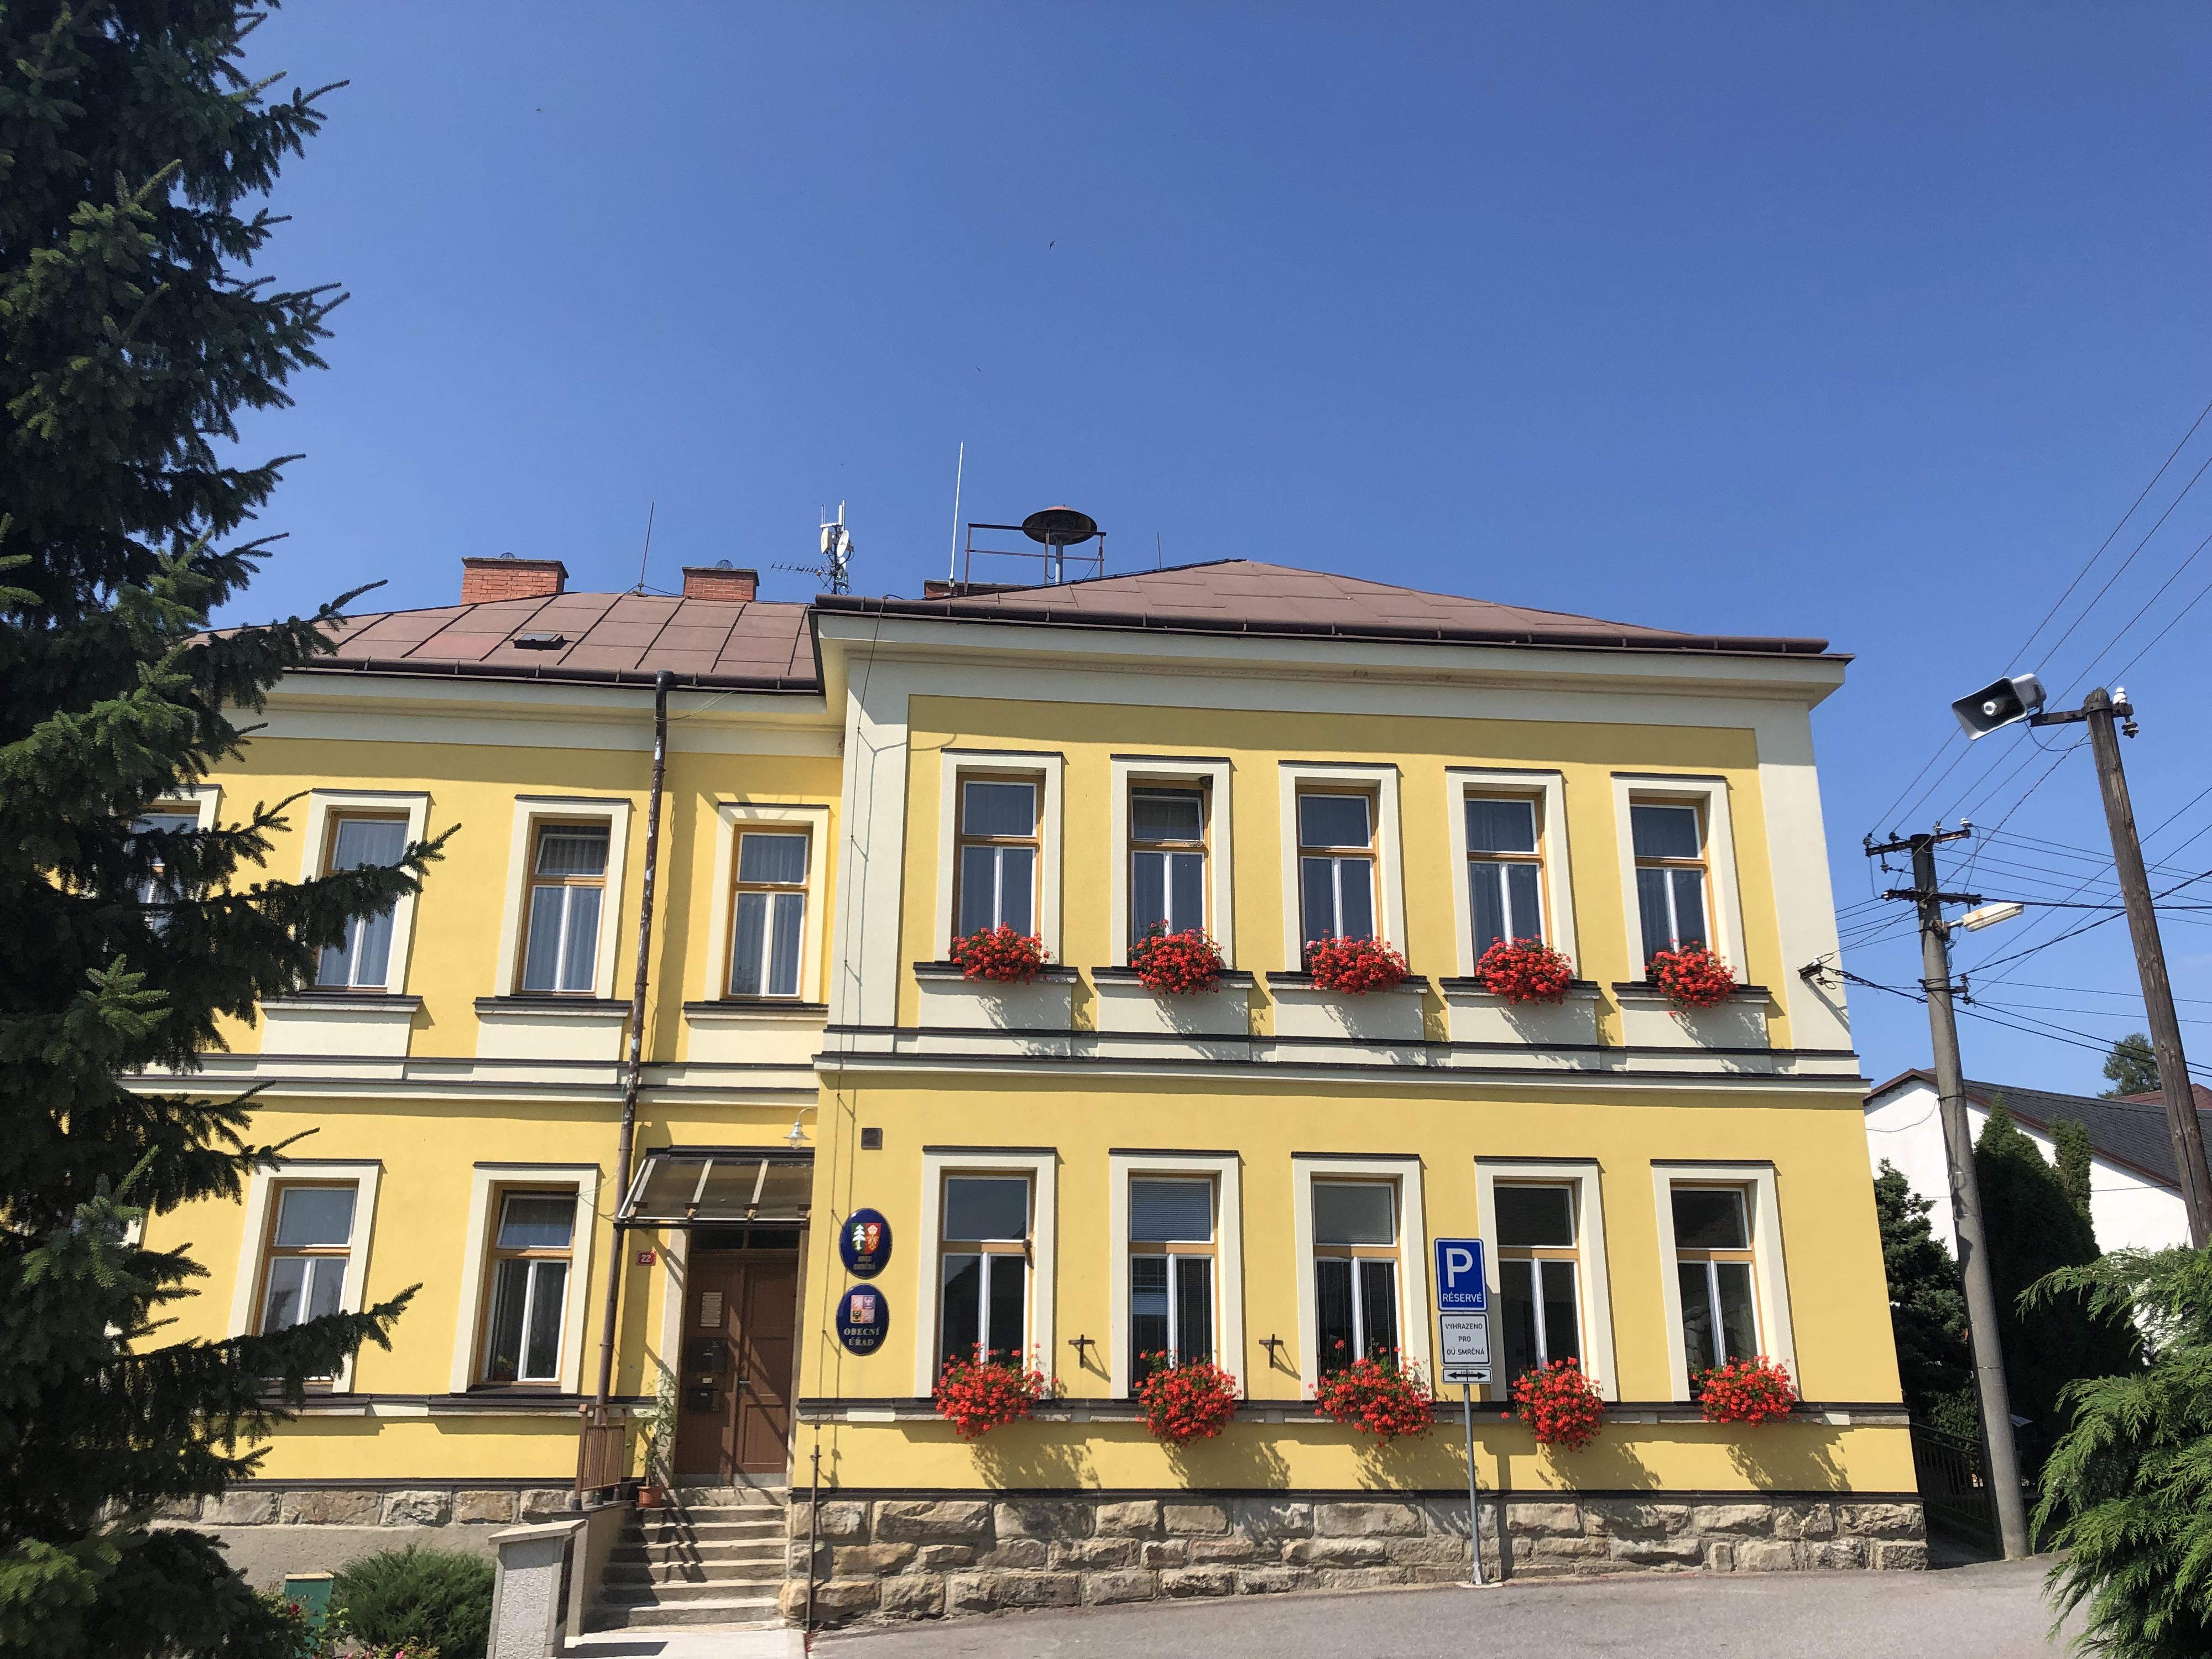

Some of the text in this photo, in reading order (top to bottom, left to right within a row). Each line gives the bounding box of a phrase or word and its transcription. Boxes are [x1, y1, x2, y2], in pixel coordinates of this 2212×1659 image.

[640, 1254, 651, 1262] 22
[1446, 1248, 1473, 1288] P
[1442, 1291, 1483, 1302] RÉSERVÉ
[843, 1327, 880, 1335] OBECNÍ
[848, 1337, 874, 1346] ÚŘAD
[1447, 1347, 1485, 1355] OÚ SMRČNÁ
